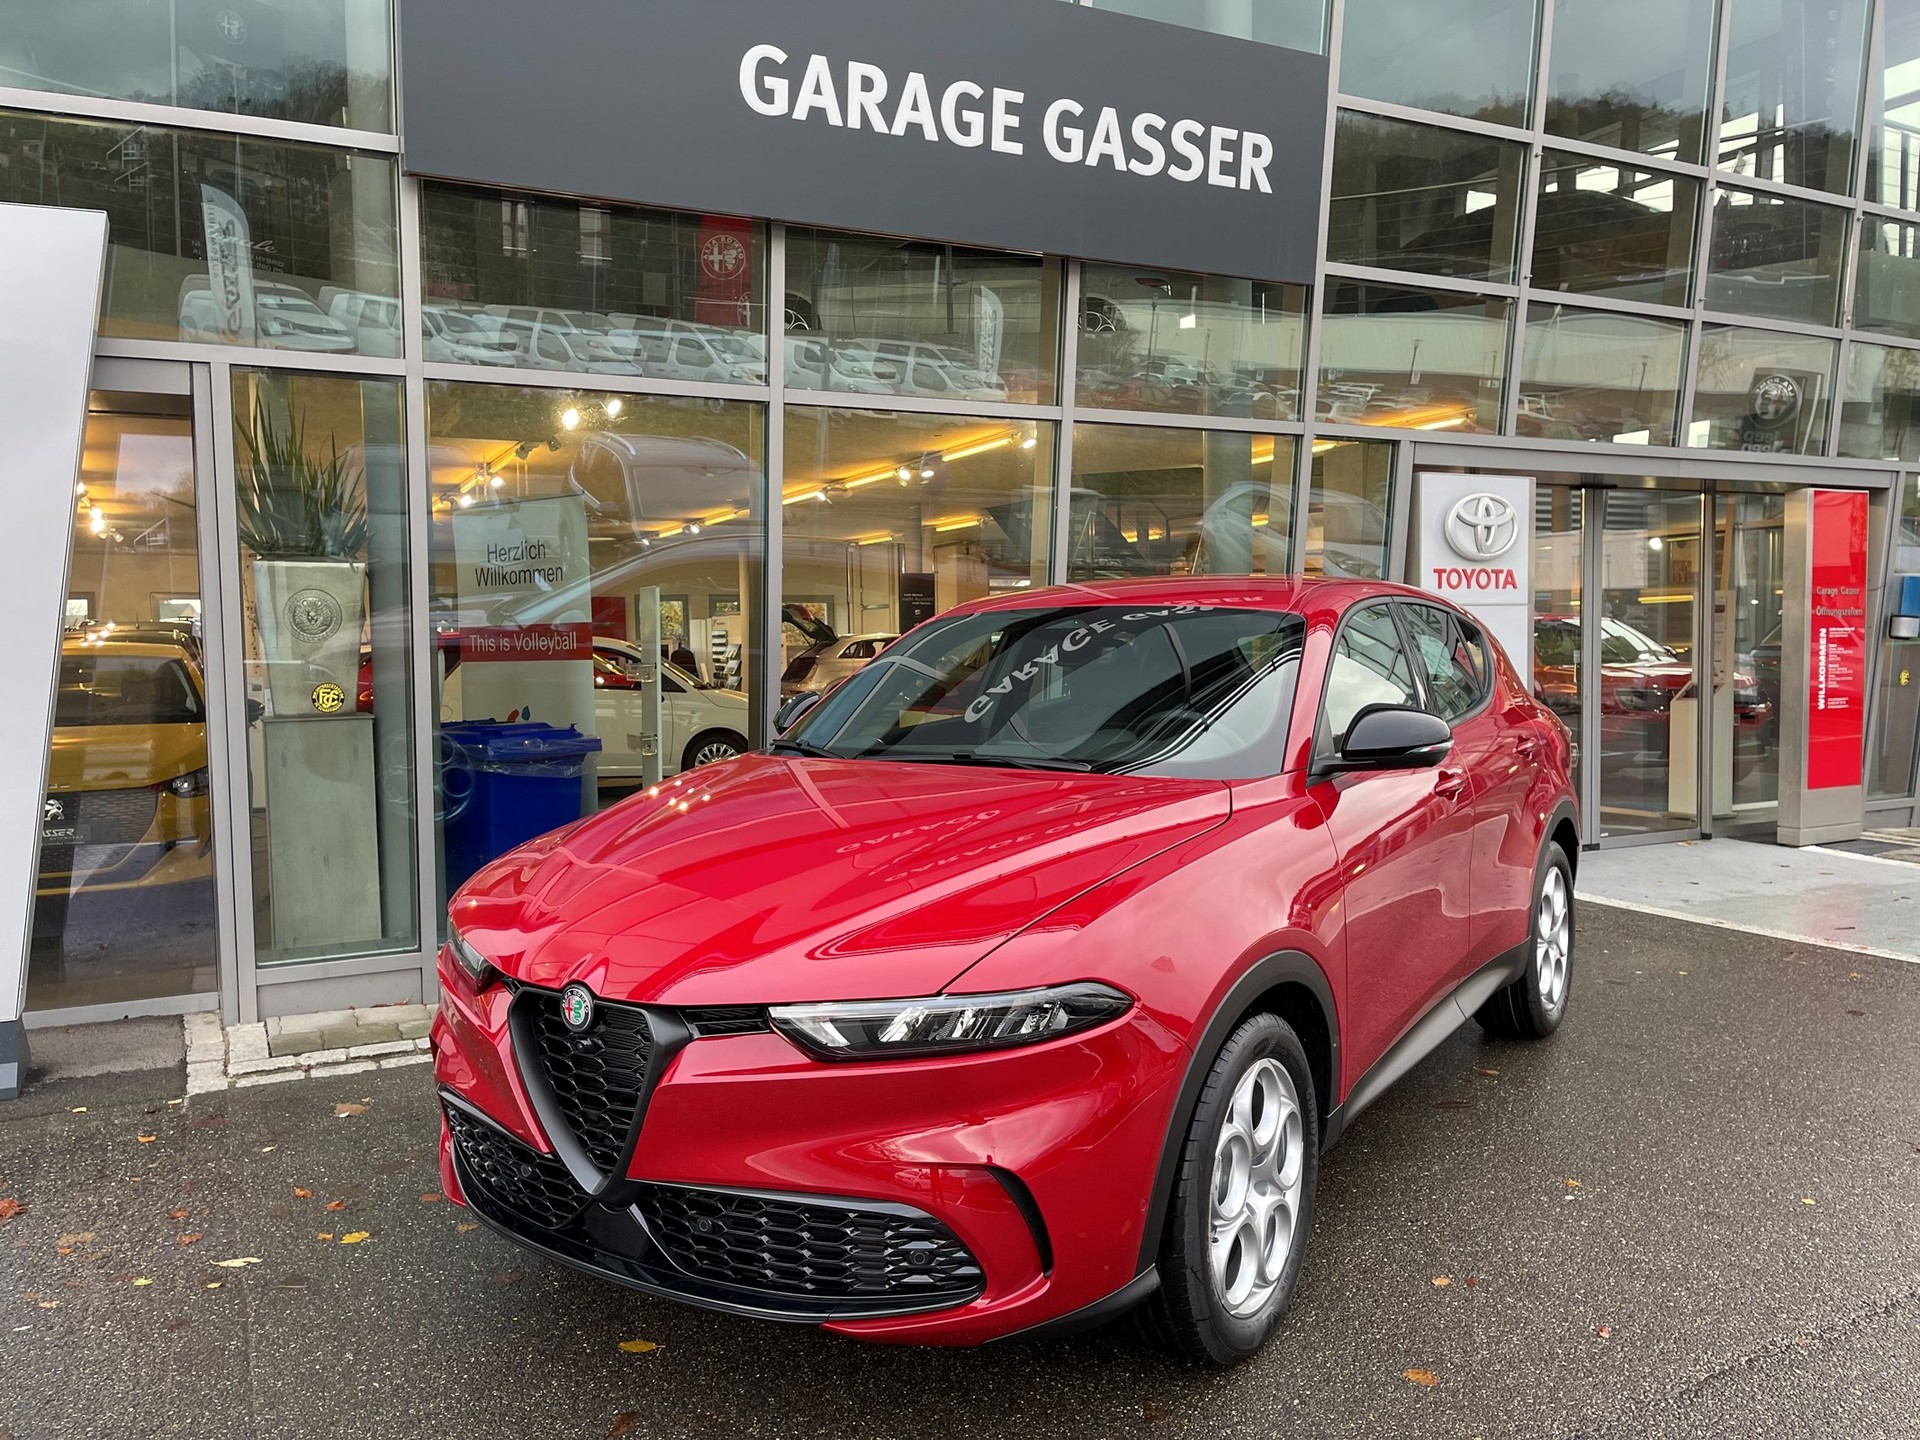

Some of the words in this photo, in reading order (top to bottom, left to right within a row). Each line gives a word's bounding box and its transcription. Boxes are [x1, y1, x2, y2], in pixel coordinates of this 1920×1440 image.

[739, 44, 1024, 155] GARAGE
[1043, 99, 1273, 193] GASSER
[486, 537, 546, 563] Herzlich
[475, 565, 563, 587] Willkommen
[1433, 568, 1517, 590] TOYOTA
[1816, 586, 1838, 597] Garage
[469, 632, 495, 652] This
[500, 632, 510, 652] is
[514, 631, 577, 655] Volleyball
[1818, 627, 1827, 710] WILLKOMMEN
